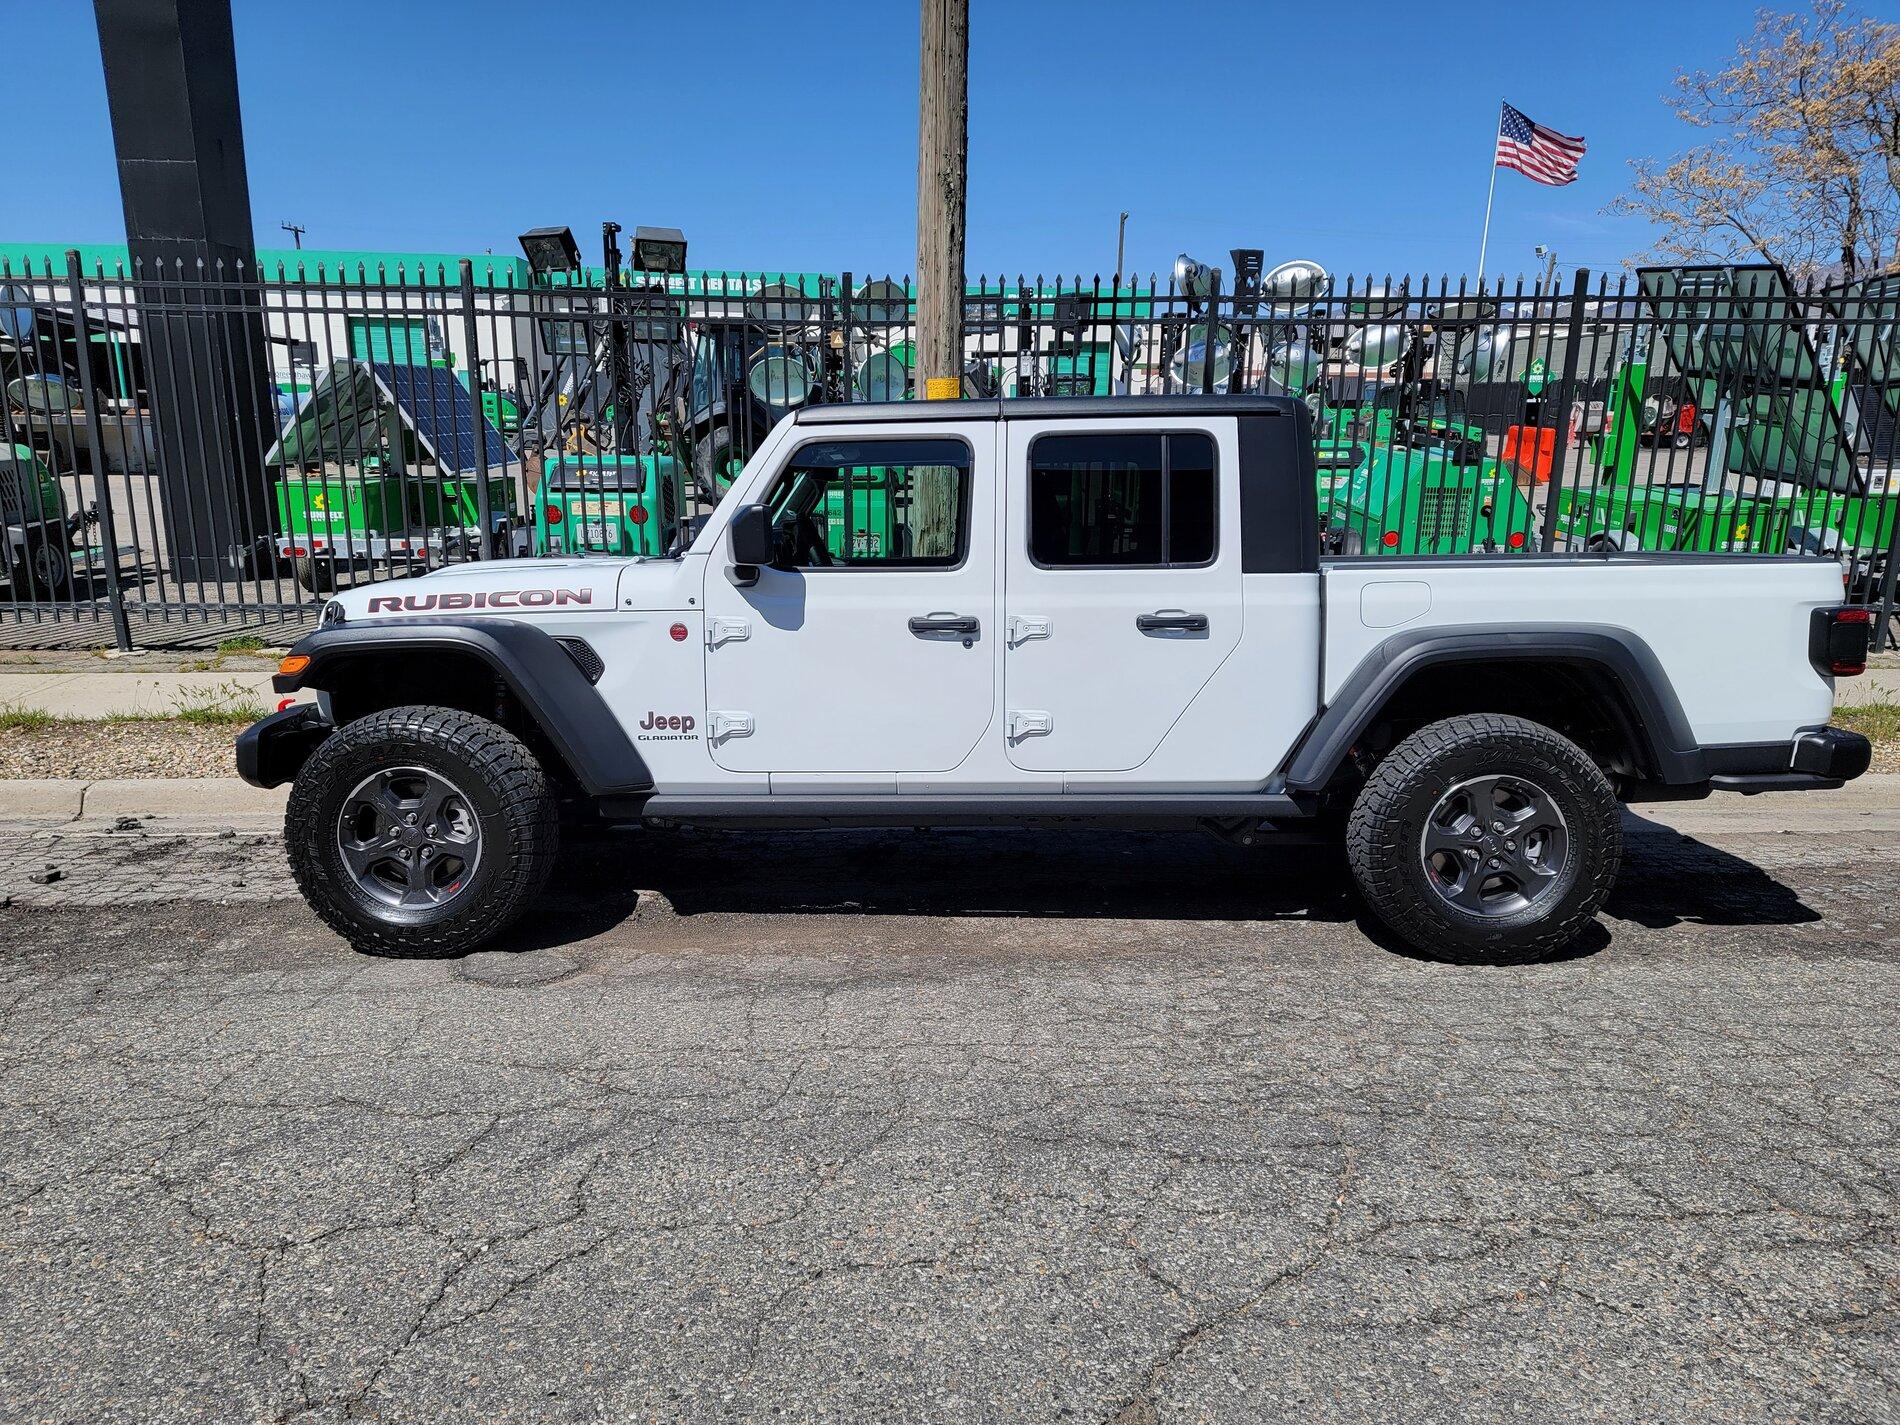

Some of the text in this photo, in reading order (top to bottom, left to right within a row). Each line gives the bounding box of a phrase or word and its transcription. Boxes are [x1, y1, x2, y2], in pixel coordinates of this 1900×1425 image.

[636, 276, 697, 289] SUNBET
[367, 588, 593, 614] RUBICON
[639, 711, 695, 733] Jeep
